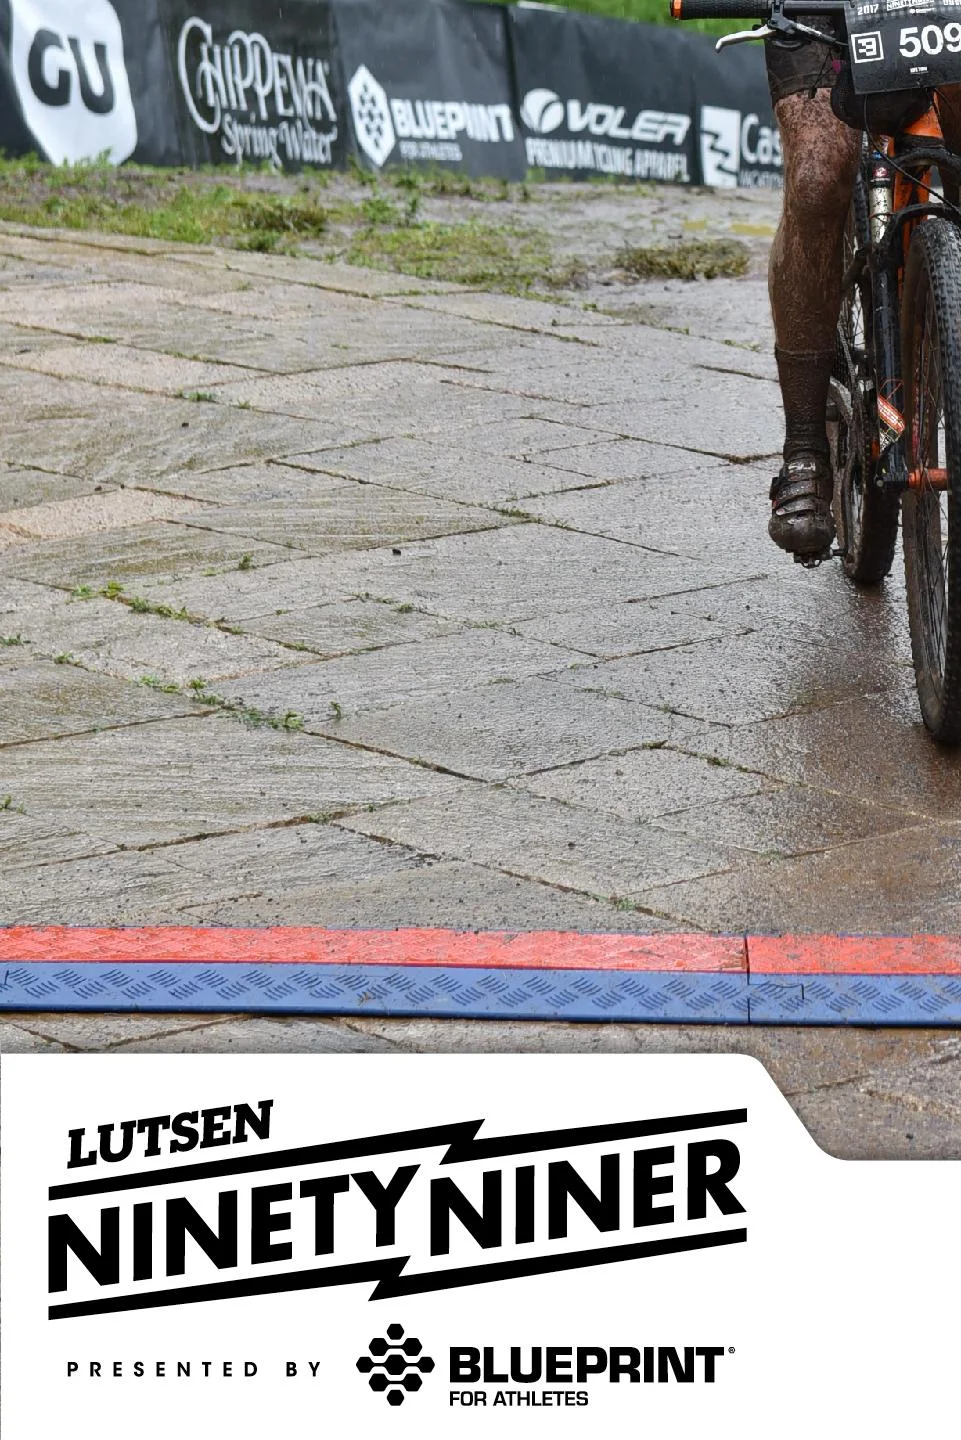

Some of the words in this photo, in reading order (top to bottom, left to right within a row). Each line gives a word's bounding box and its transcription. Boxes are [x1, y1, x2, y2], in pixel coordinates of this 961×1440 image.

[857, 4, 879, 15] 2017
[28, 28, 116, 113] GU
[178, 16, 338, 133] CHIPPEWA
[567, 99, 692, 146] VOLER
